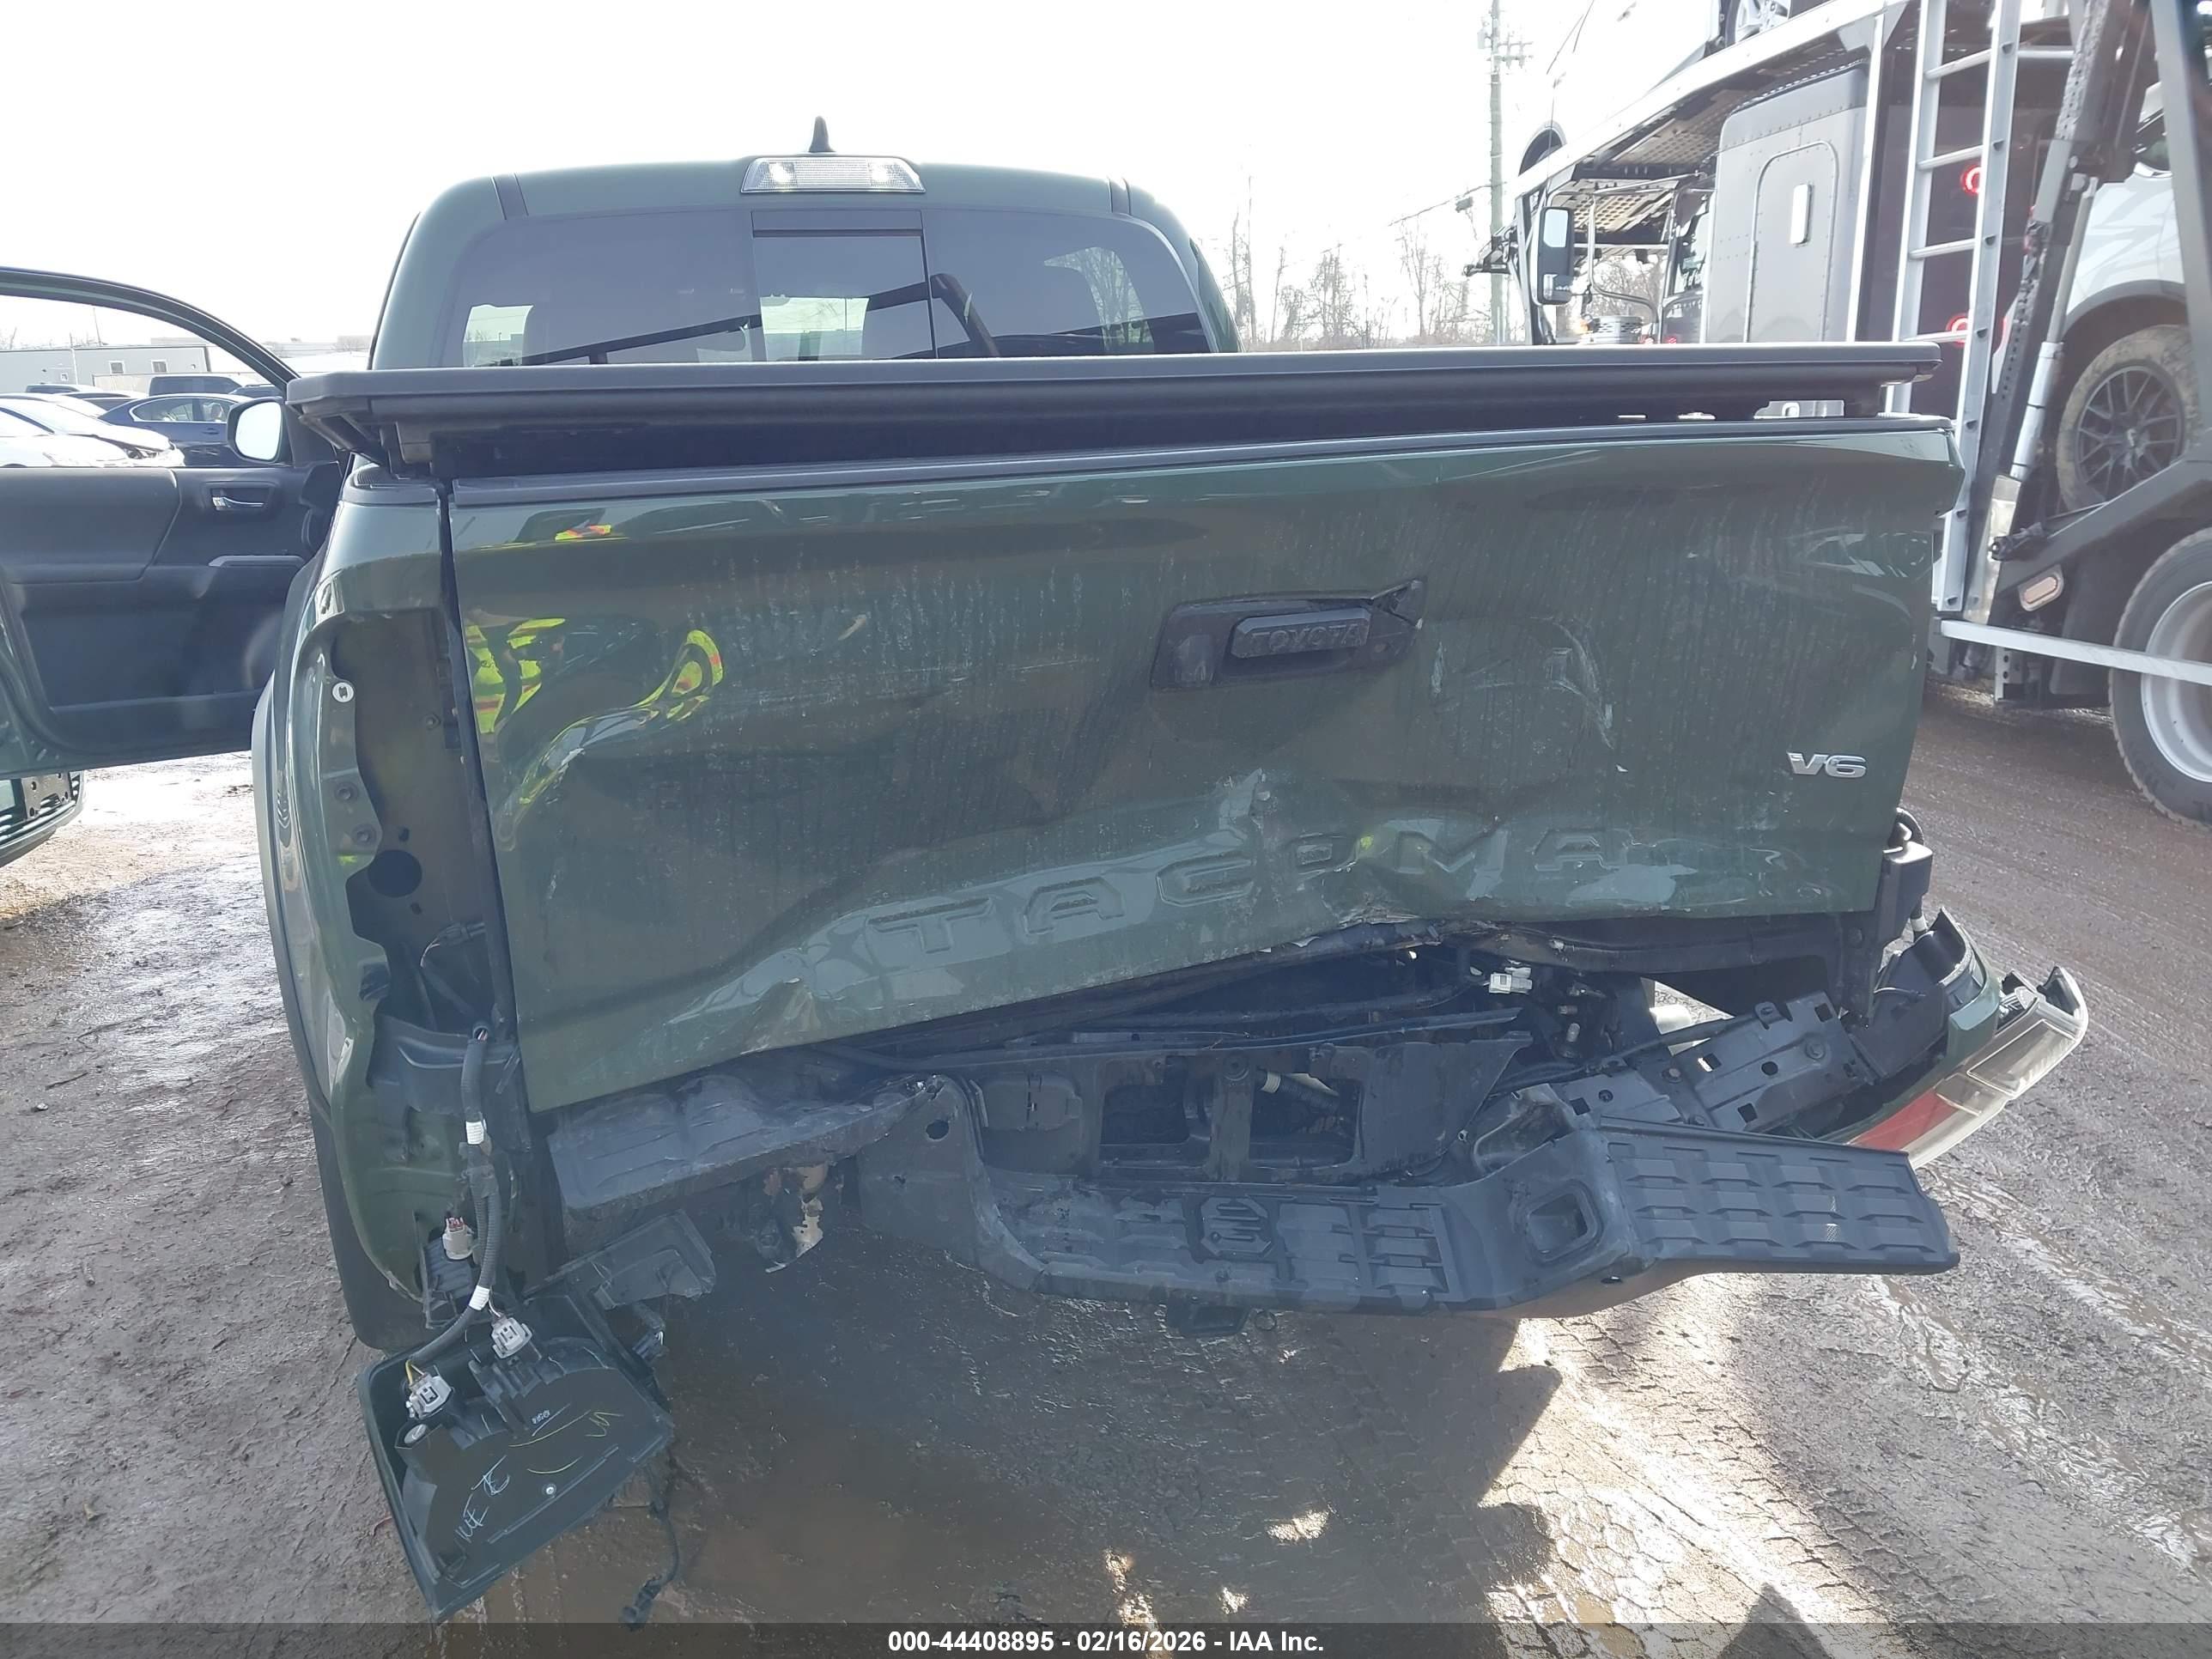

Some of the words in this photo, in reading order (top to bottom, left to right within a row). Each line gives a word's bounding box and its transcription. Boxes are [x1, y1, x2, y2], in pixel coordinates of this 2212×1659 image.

[1249, 622, 1364, 653] TOYOTA
[1787, 751, 1867, 778] V6
[864, 819, 1634, 955] TACOMA
